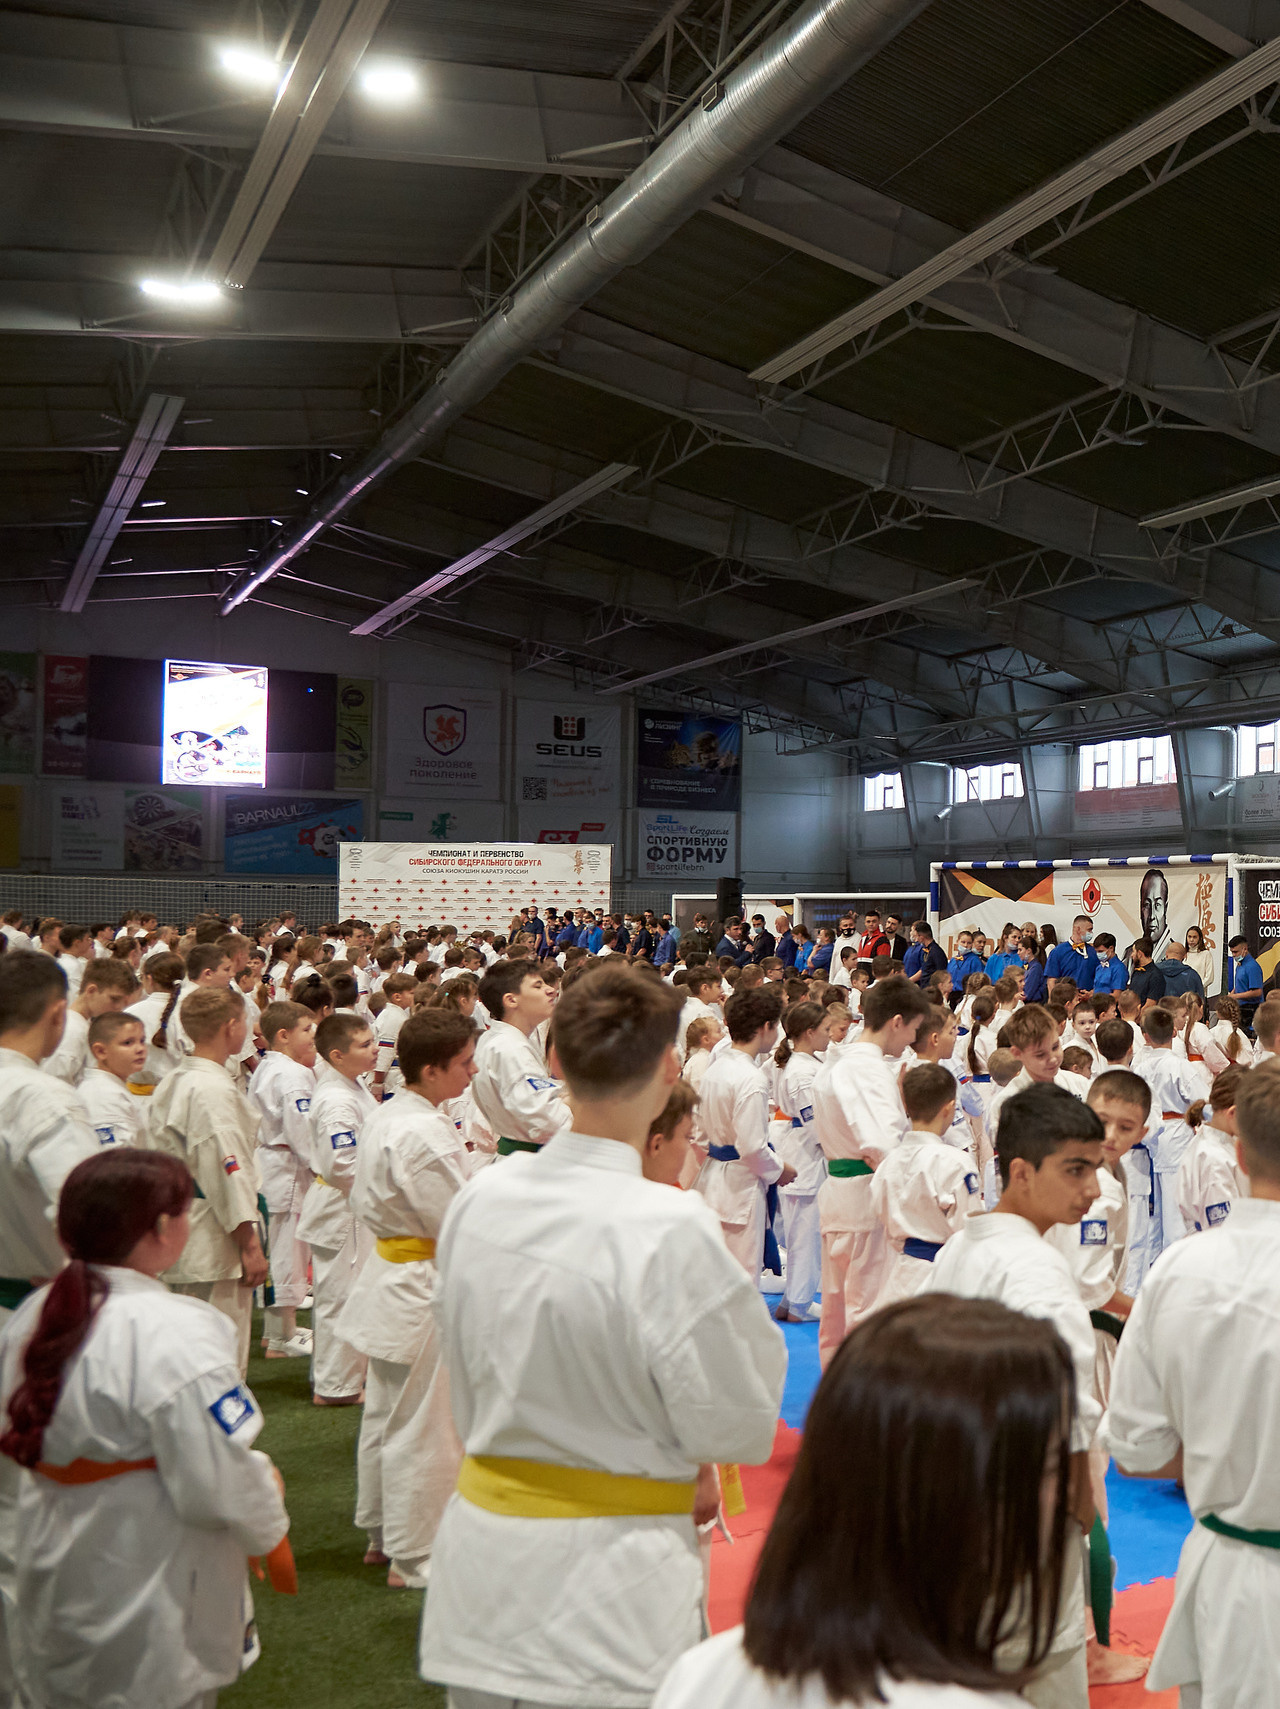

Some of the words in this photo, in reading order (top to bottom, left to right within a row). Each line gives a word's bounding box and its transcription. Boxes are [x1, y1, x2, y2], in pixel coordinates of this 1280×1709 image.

[536, 743, 601, 757] SEUS
[415, 757, 473, 769] Здоровое
[409, 769, 477, 780] поколение
[647, 835, 728, 847] СПОРТИВНУЮ
[428, 850, 471, 858] ЧЕМПИОНАТ
[647, 846, 728, 863] ФОРМУ
[409, 858, 456, 866] СИБИРСКОГО
[457, 859, 513, 867] ФЕДЕРАЛЬНОГО
[514, 859, 542, 867] ОКРУГА
